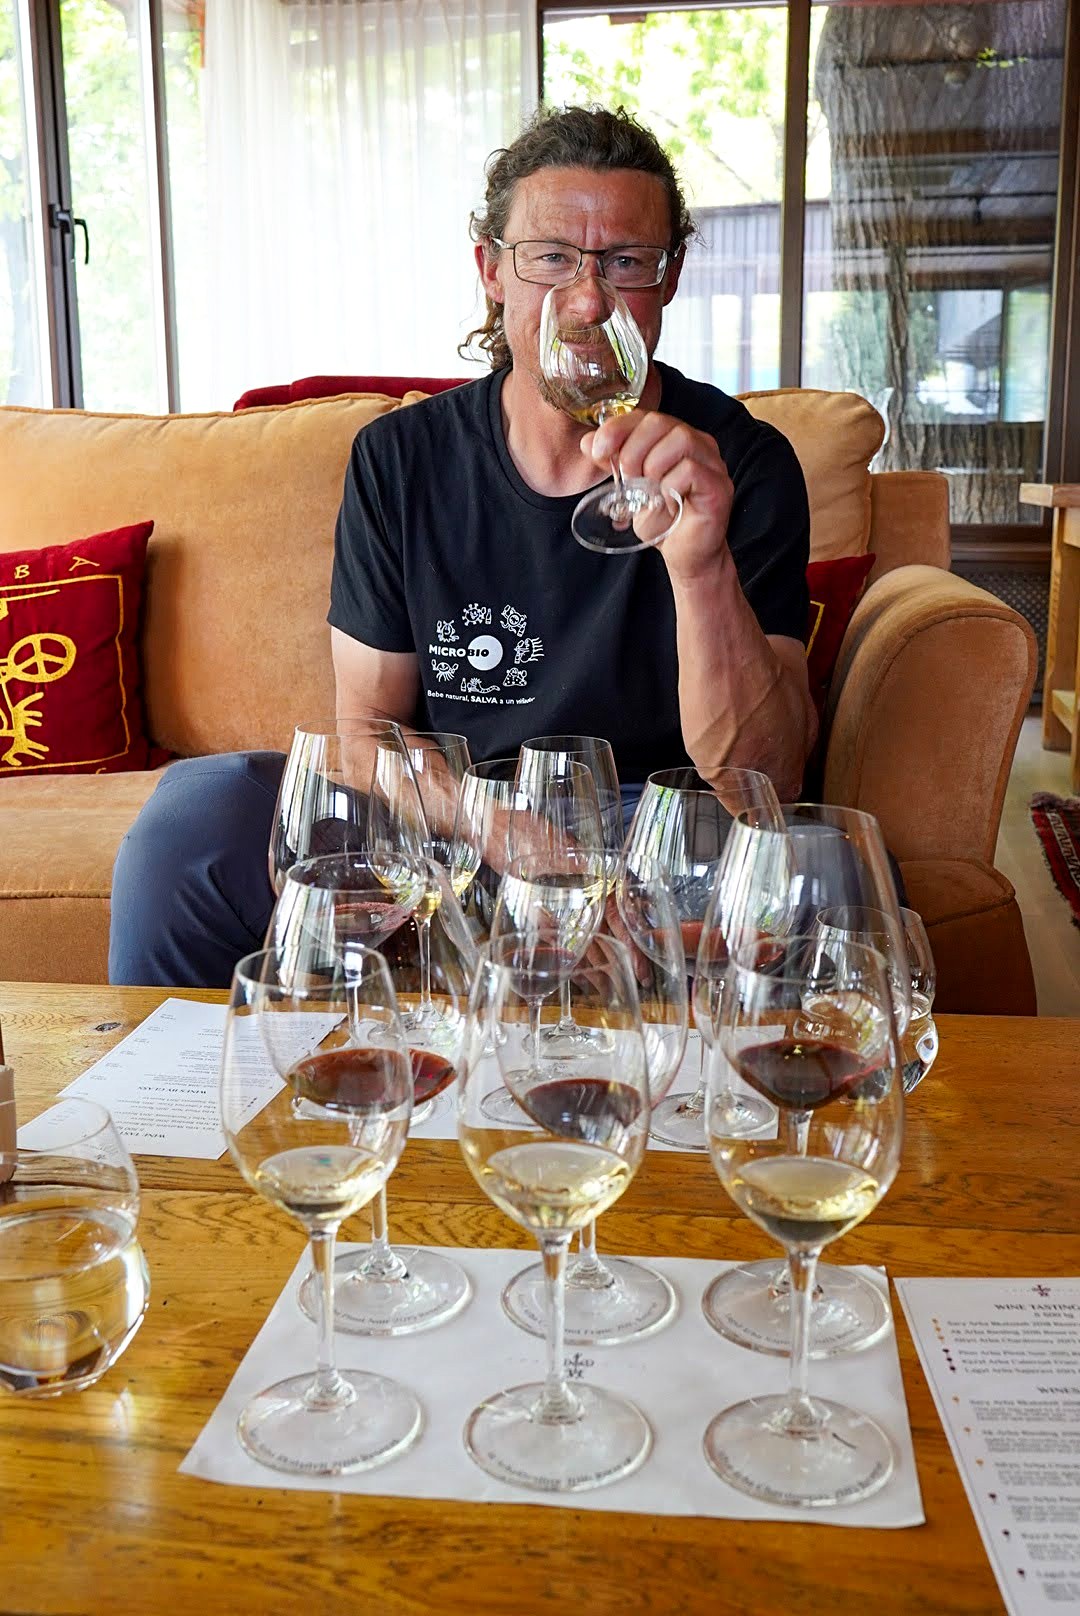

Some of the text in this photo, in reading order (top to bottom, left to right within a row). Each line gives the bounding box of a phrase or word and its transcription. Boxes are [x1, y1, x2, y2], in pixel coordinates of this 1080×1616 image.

[427, 689, 444, 698] Bebe
[445, 693, 470, 702] natural,
[470, 695, 498, 705] SALVA
